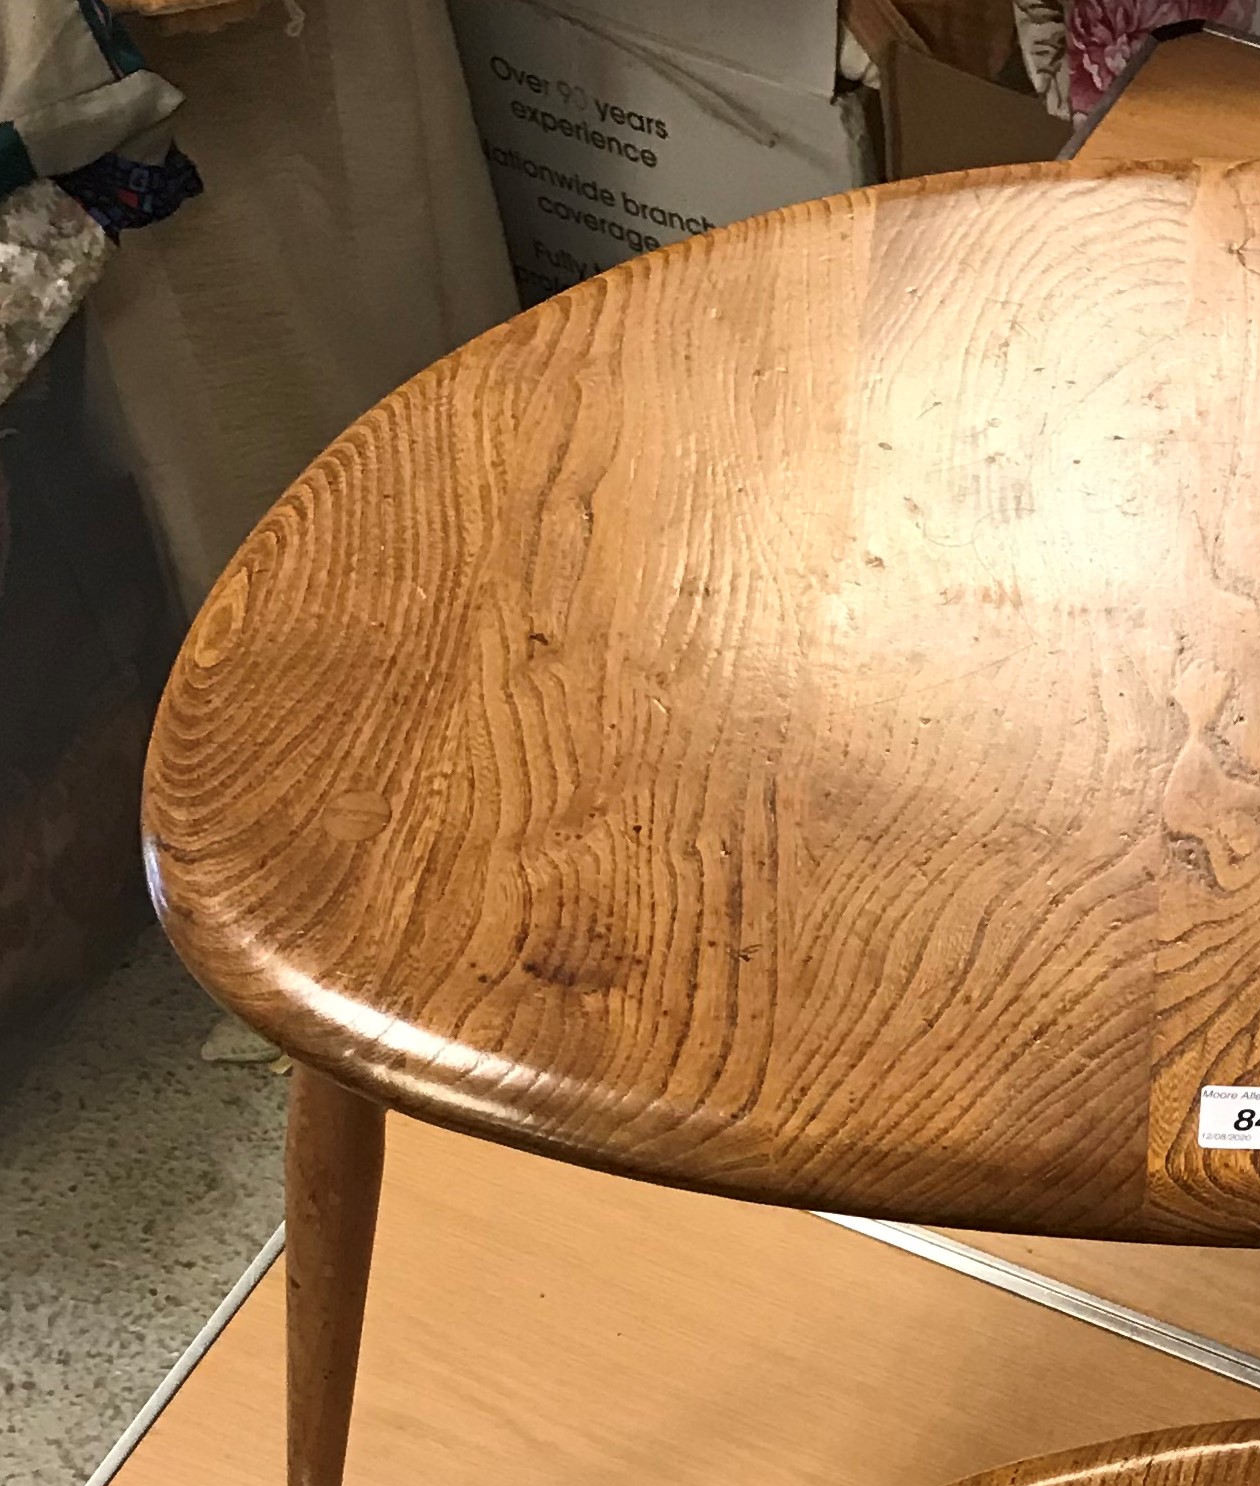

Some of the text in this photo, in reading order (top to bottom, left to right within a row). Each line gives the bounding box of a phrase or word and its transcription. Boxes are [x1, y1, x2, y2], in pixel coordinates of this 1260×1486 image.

[490, 56, 669, 139] Over 90 years
[511, 100, 657, 168] experience
[537, 196, 660, 252] coverage
[1203, 1089, 1238, 1100] Moore
